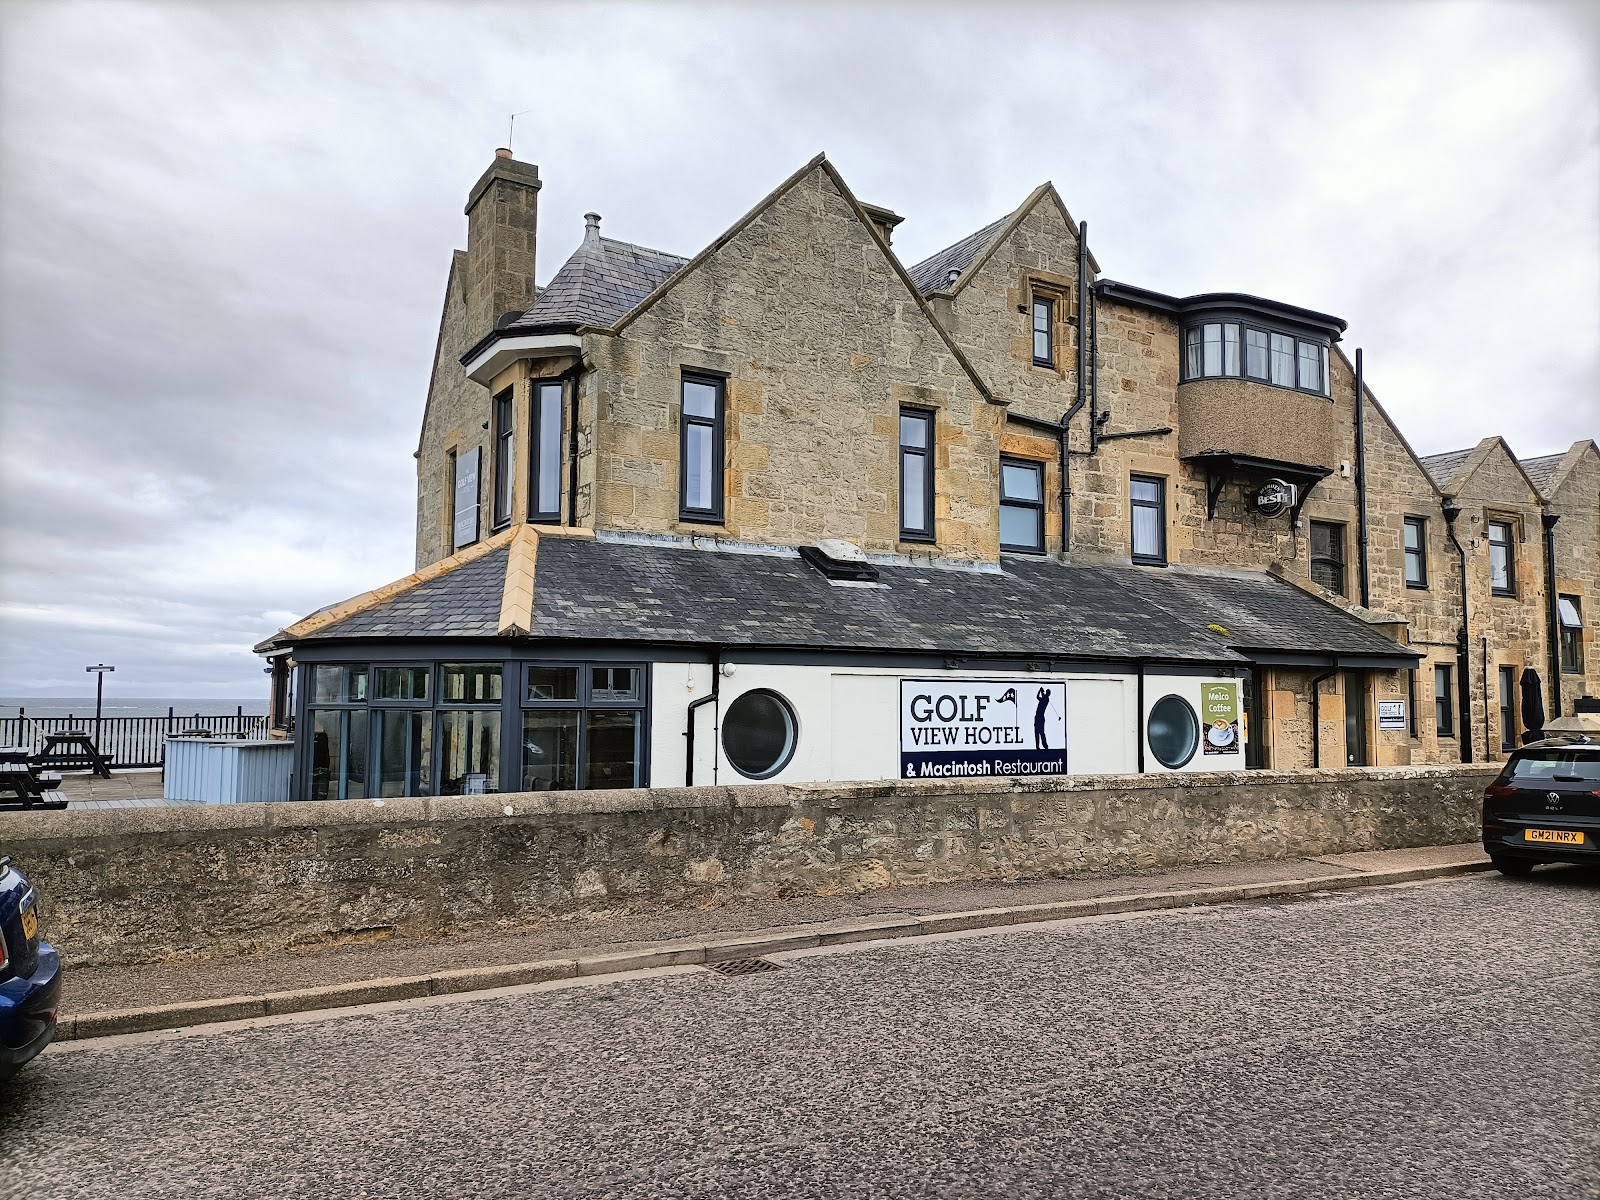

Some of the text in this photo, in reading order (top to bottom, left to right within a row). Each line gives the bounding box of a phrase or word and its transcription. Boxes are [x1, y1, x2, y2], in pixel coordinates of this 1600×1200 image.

[1257, 492, 1284, 506] BEST
[1208, 692, 1229, 701] Melco
[910, 694, 990, 723] GOLF
[1208, 704, 1232, 713] Coffee
[910, 726, 1024, 746] VIEW HOTEL
[906, 758, 1063, 777] & Macintosh Restaurant
[1531, 830, 1577, 842] GM21 NRX
